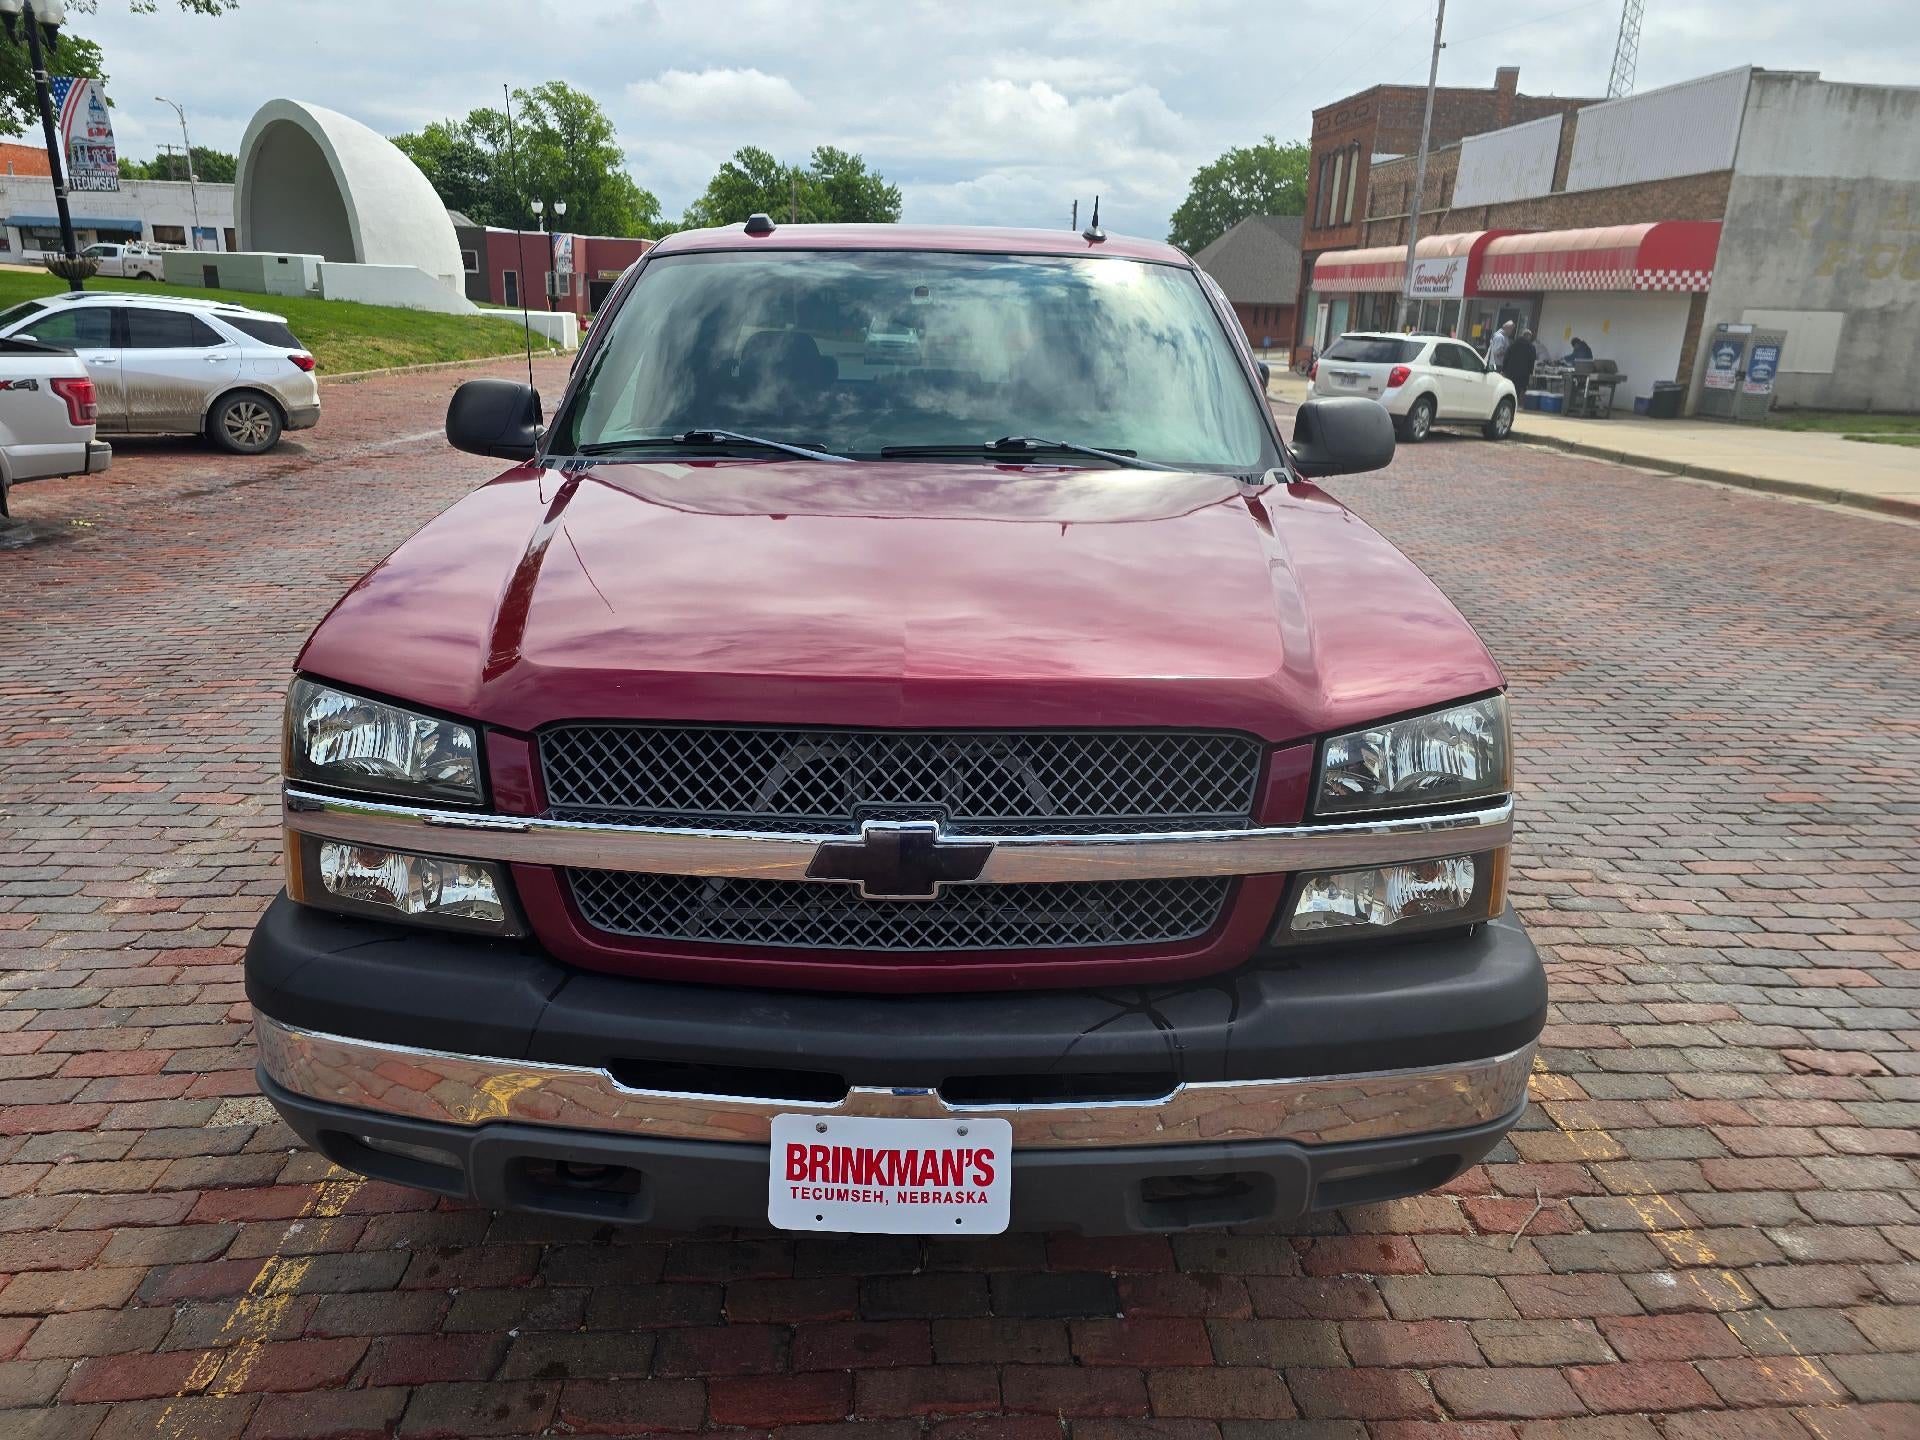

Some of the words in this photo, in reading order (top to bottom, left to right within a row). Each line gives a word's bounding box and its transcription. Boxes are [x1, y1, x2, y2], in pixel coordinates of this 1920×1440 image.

[70, 176, 118, 190] TECUMSEH
[785, 1143, 995, 1187] BRINKMAN'S
[790, 1186, 889, 1205] TECUMSEH,
[897, 1190, 988, 1204] NEBRASKA
